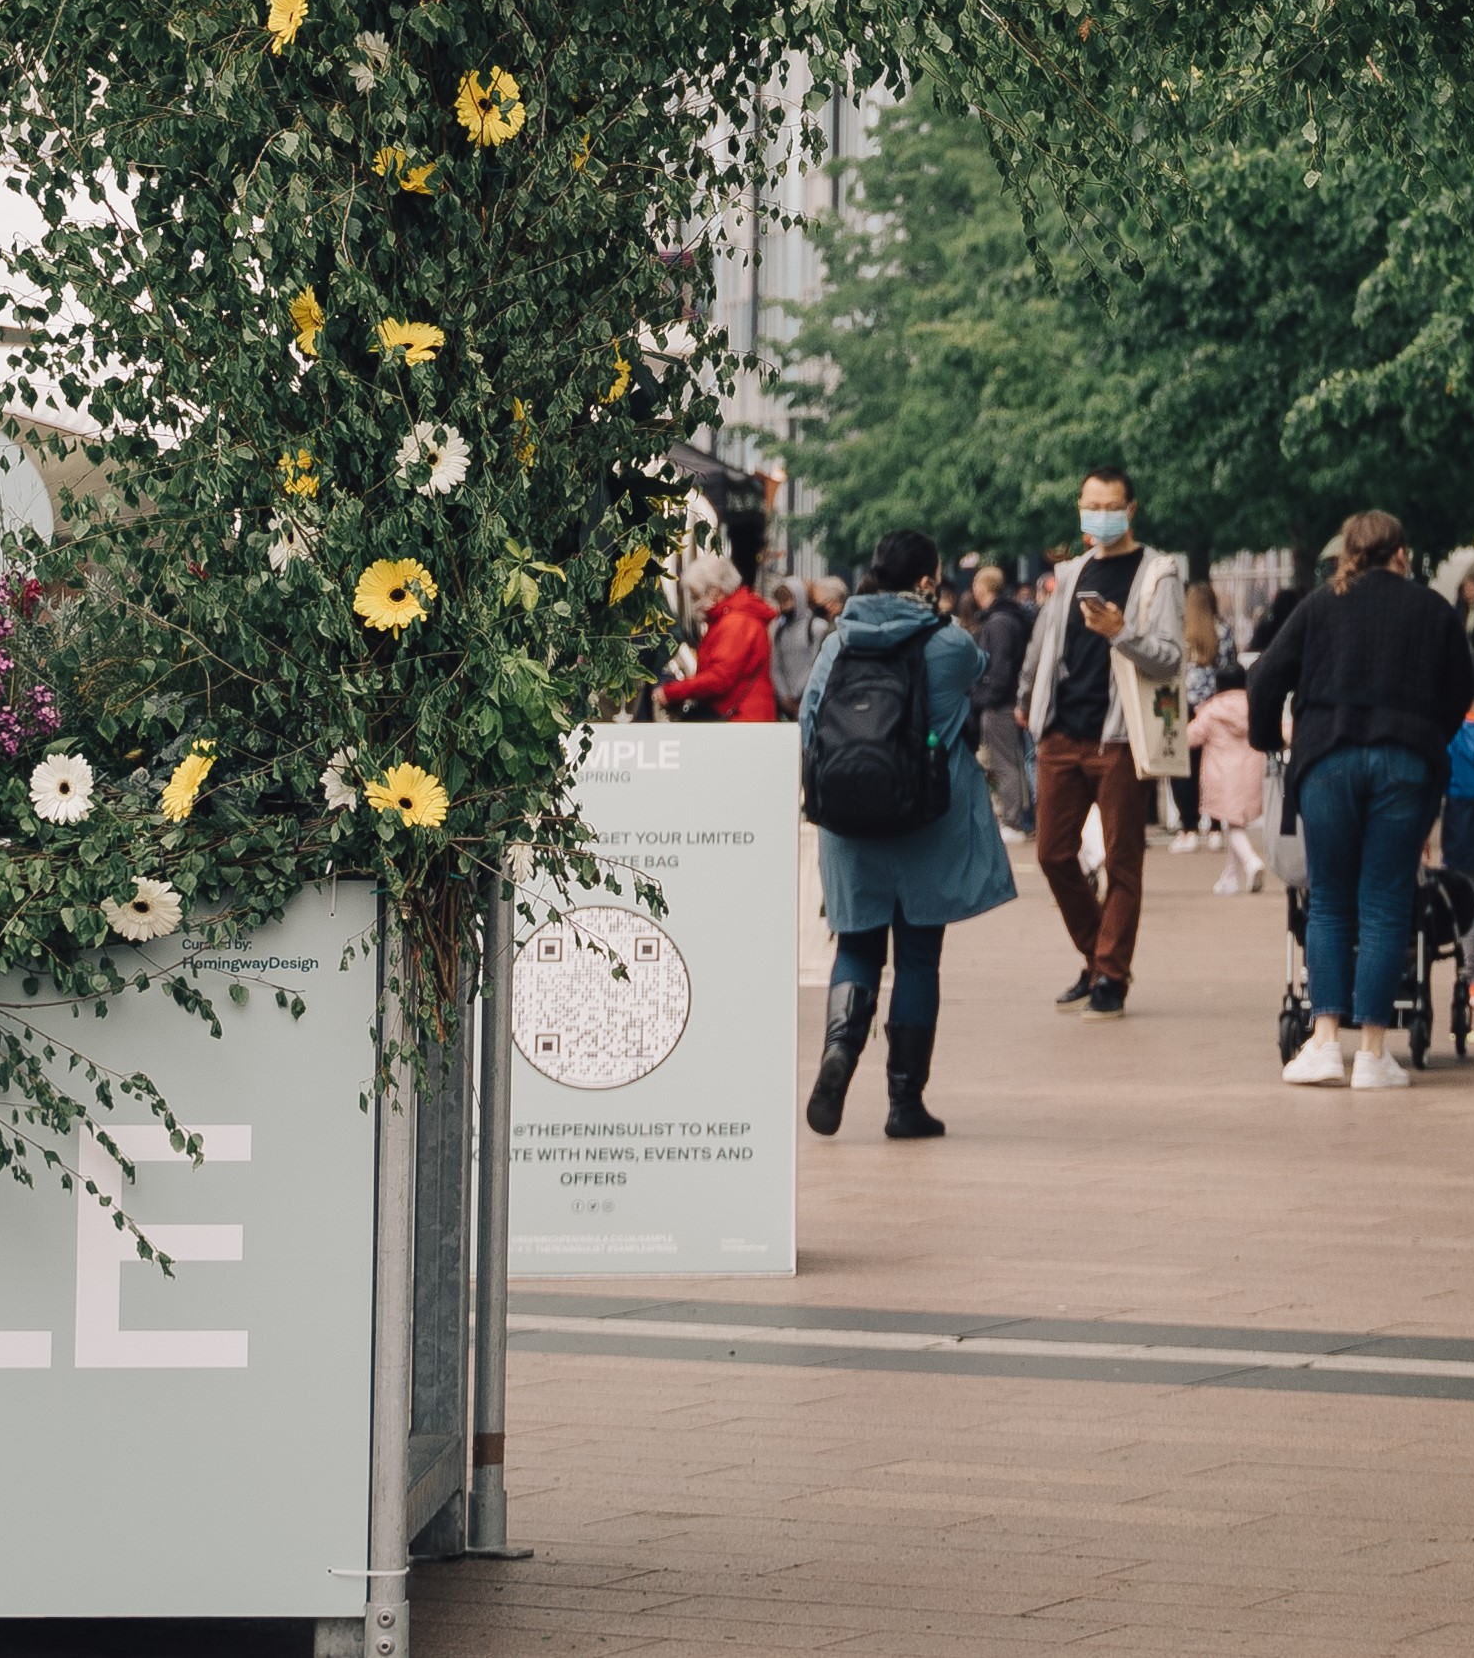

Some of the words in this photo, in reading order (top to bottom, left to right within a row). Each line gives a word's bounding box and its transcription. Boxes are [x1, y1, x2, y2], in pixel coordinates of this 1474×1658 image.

[599, 831, 631, 845] GET
[636, 831, 681, 845] YOUR
[686, 831, 755, 845] LIMITED
[644, 854, 679, 868] BAG
[182, 956, 320, 973] HemingwayDesign
[513, 1123, 674, 1138] @THEPENINSULIST
[679, 1122, 701, 1137] TO
[706, 1122, 751, 1137] KEEP
[537, 1147, 580, 1161] WITH
[585, 1147, 640, 1163] NEWS,
[644, 1146, 712, 1161] EVENTS
[716, 1146, 754, 1161] AND
[559, 1171, 627, 1186] OFFERS
